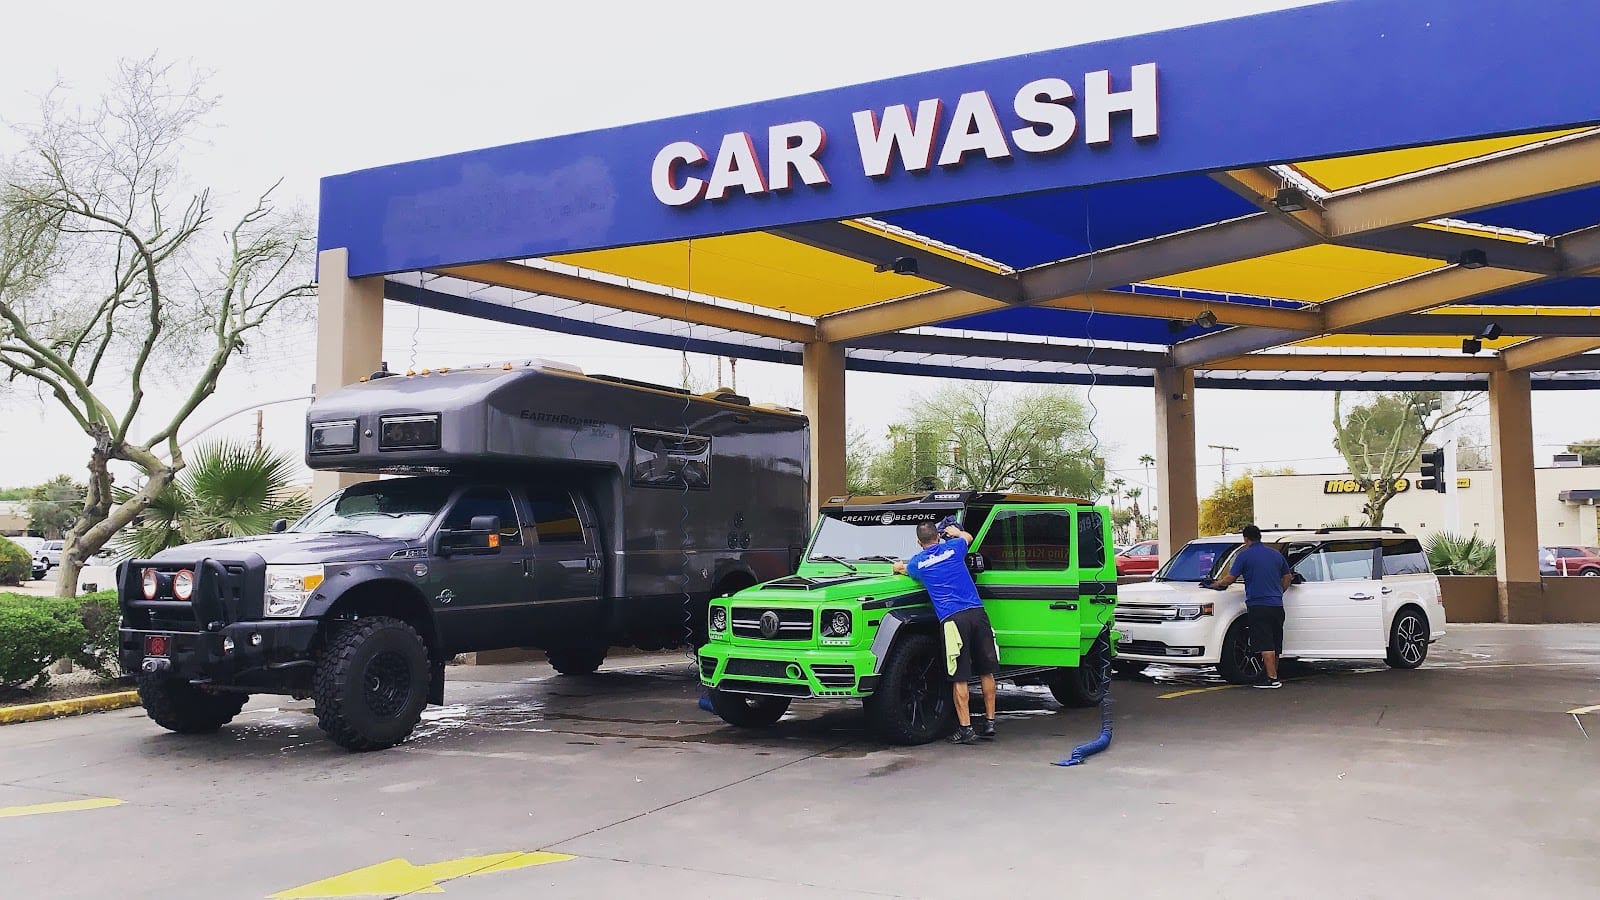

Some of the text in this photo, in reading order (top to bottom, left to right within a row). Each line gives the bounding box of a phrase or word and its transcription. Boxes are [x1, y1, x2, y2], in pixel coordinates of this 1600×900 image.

[650, 62, 1158, 207] CAR WASH
[841, 513, 936, 524] CREATIVE BESPOKE
